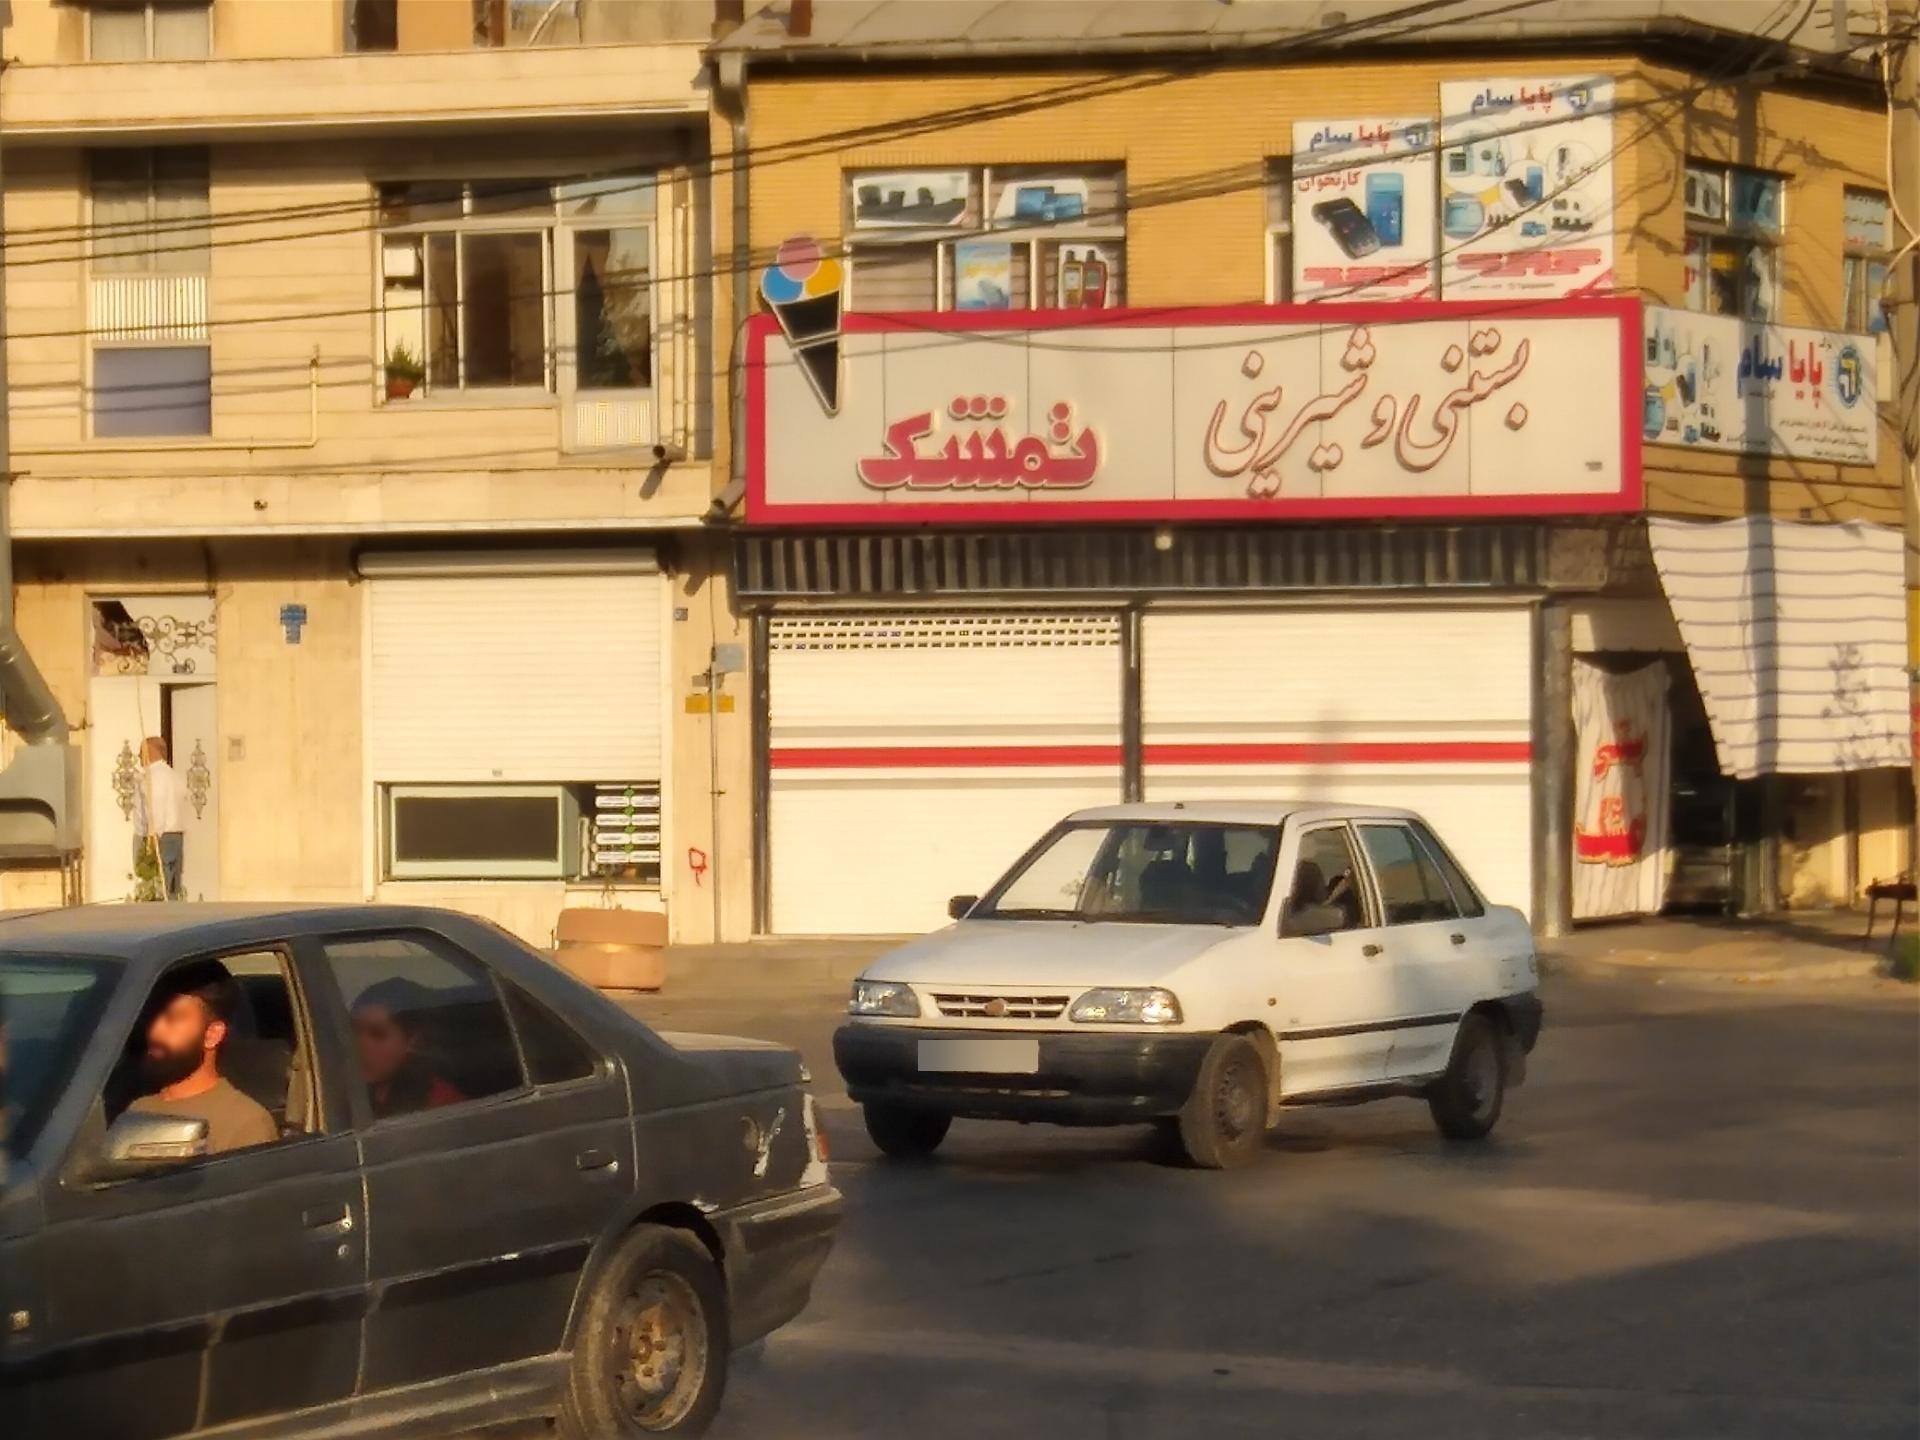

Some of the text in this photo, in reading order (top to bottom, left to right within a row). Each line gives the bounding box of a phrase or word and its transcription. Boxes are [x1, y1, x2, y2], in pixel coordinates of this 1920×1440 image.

[857, 396, 1099, 492] تمشک
[1203, 325, 1530, 499] بستنی و شیرینی
